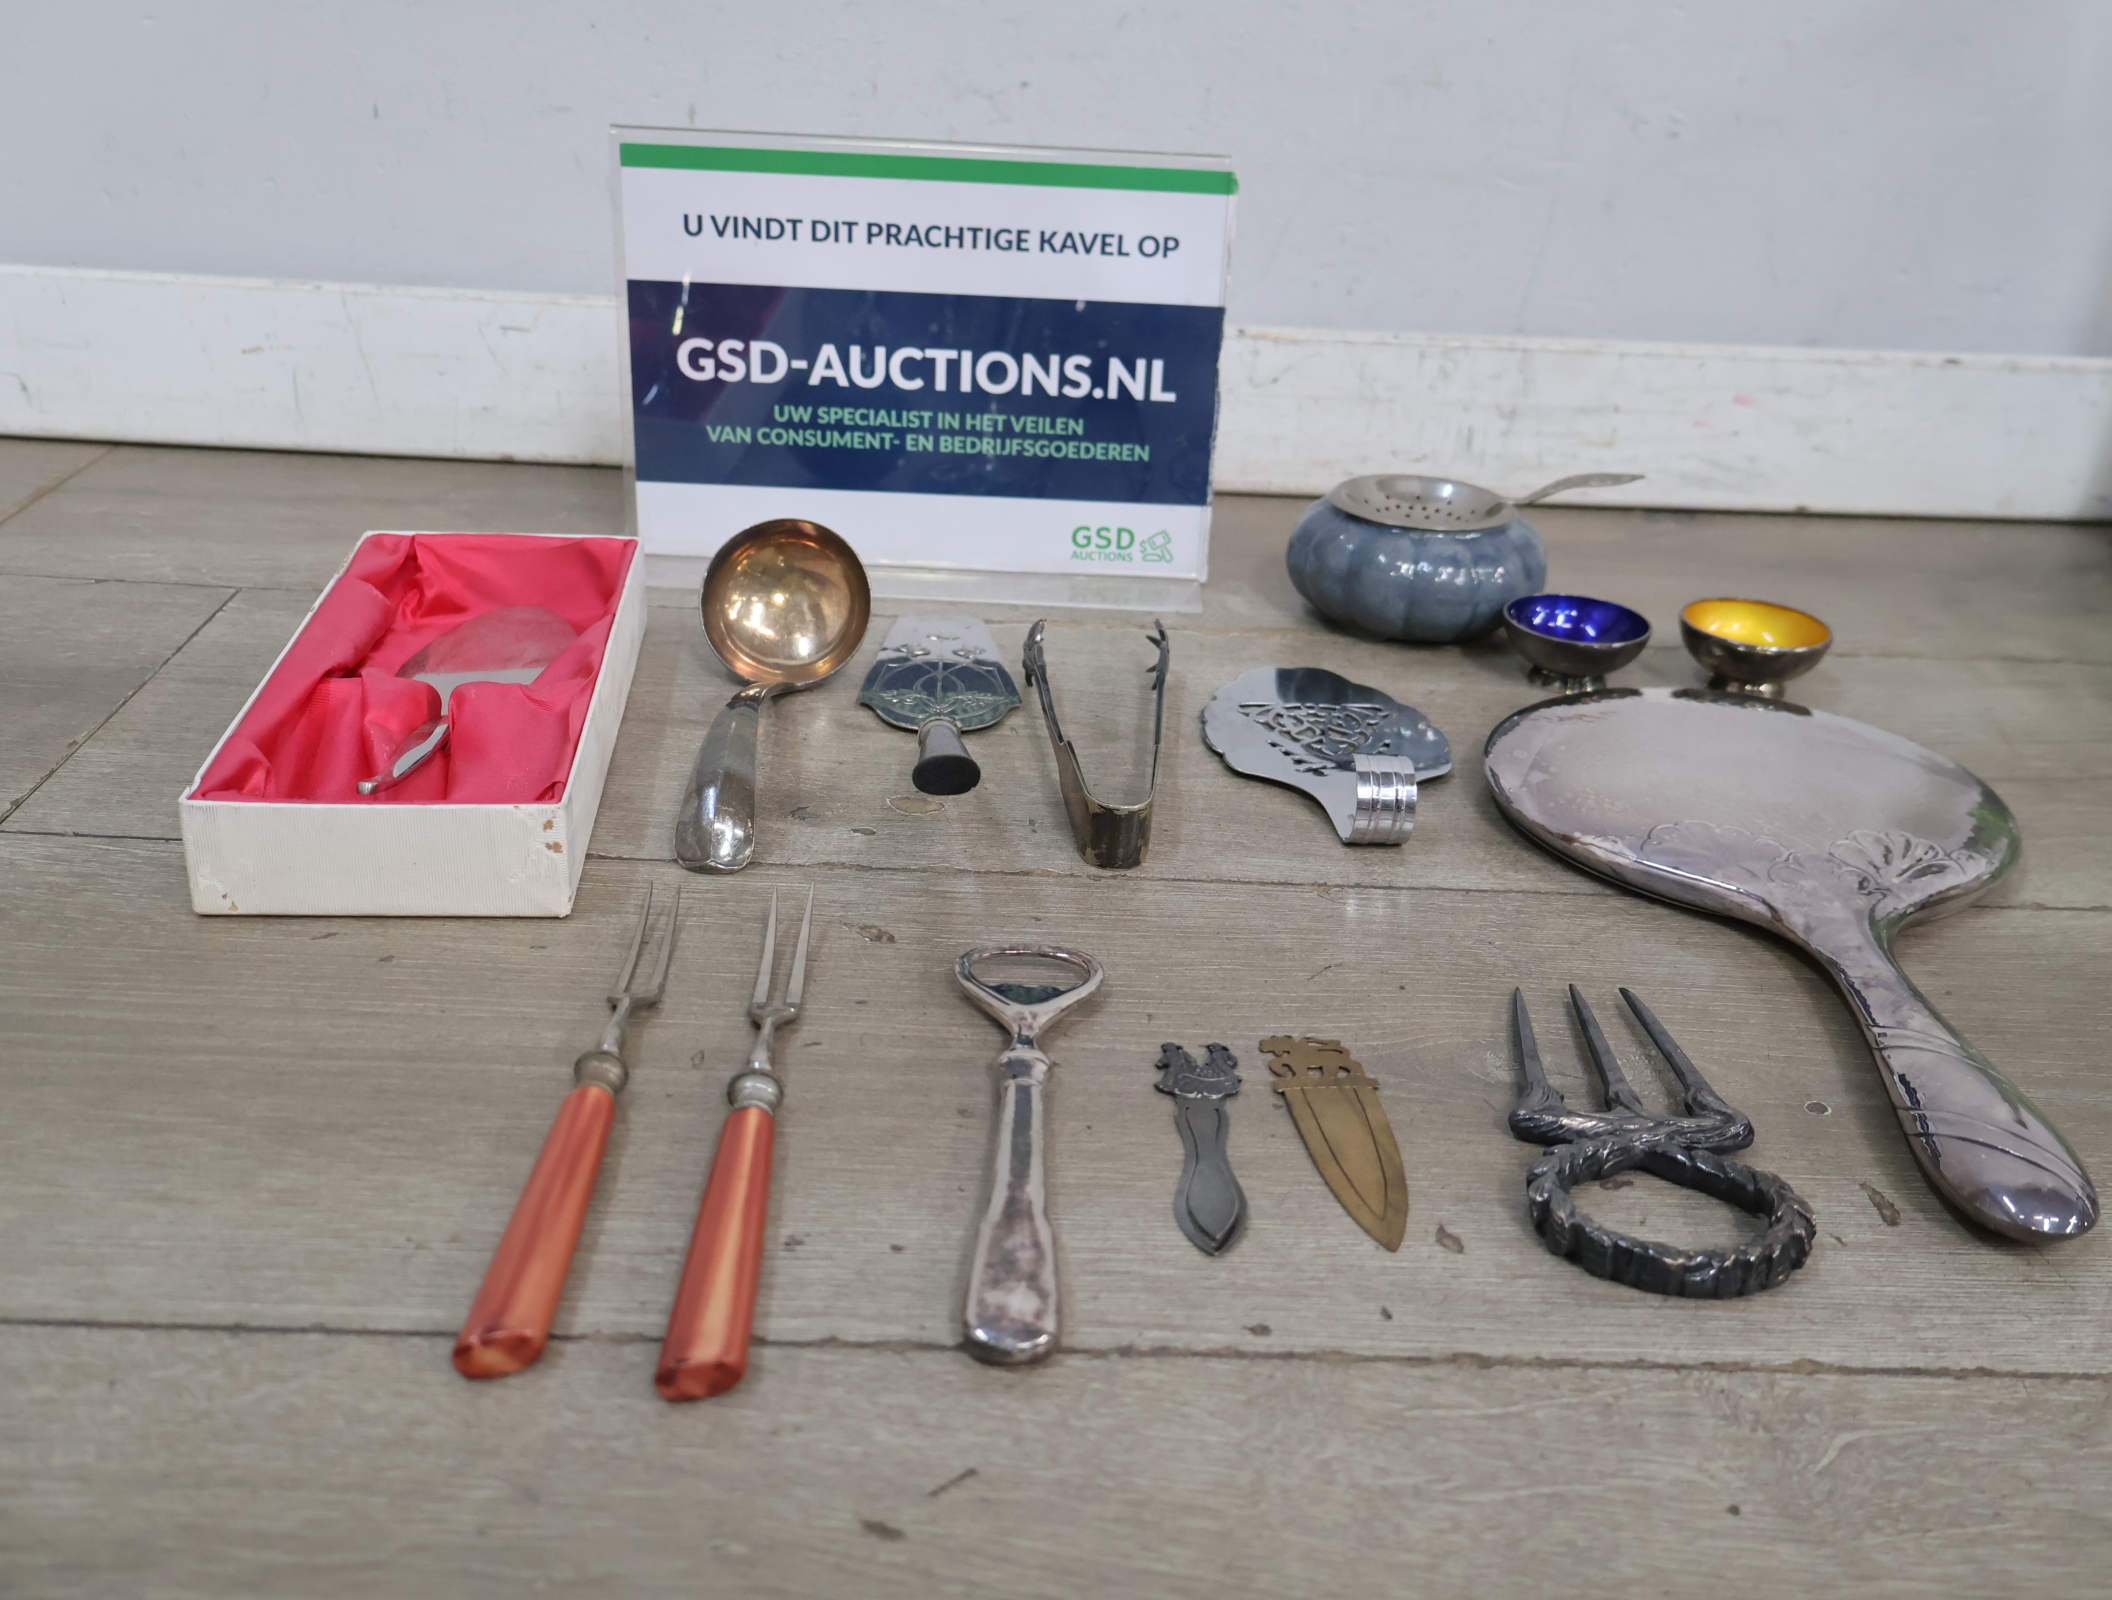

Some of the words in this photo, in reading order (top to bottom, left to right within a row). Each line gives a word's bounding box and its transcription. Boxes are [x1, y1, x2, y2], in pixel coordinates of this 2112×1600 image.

[683, 213, 704, 237] U
[710, 215, 803, 242] VINDT
[811, 220, 859, 244] DIT
[866, 223, 1031, 253] PRACHTIGE
[1038, 231, 1130, 257] KAVEL
[1138, 236, 1180, 259] OP
[676, 337, 1177, 403] GSD-AUCTIONS.NL
[773, 404, 812, 423] UW
[816, 406, 931, 429] SPECIALIST
[937, 412, 959, 430] IN
[965, 413, 1008, 432] HET
[1010, 415, 1084, 435] VEILEN
[705, 424, 752, 444] VAN
[756, 427, 901, 450] CONSUMENT-
[905, 434, 934, 452] EN
[938, 435, 1150, 462] BEDRIJFSGOEDEREN
[1071, 525, 1135, 550] GSD
[1070, 550, 1133, 563] AUCTIONS
